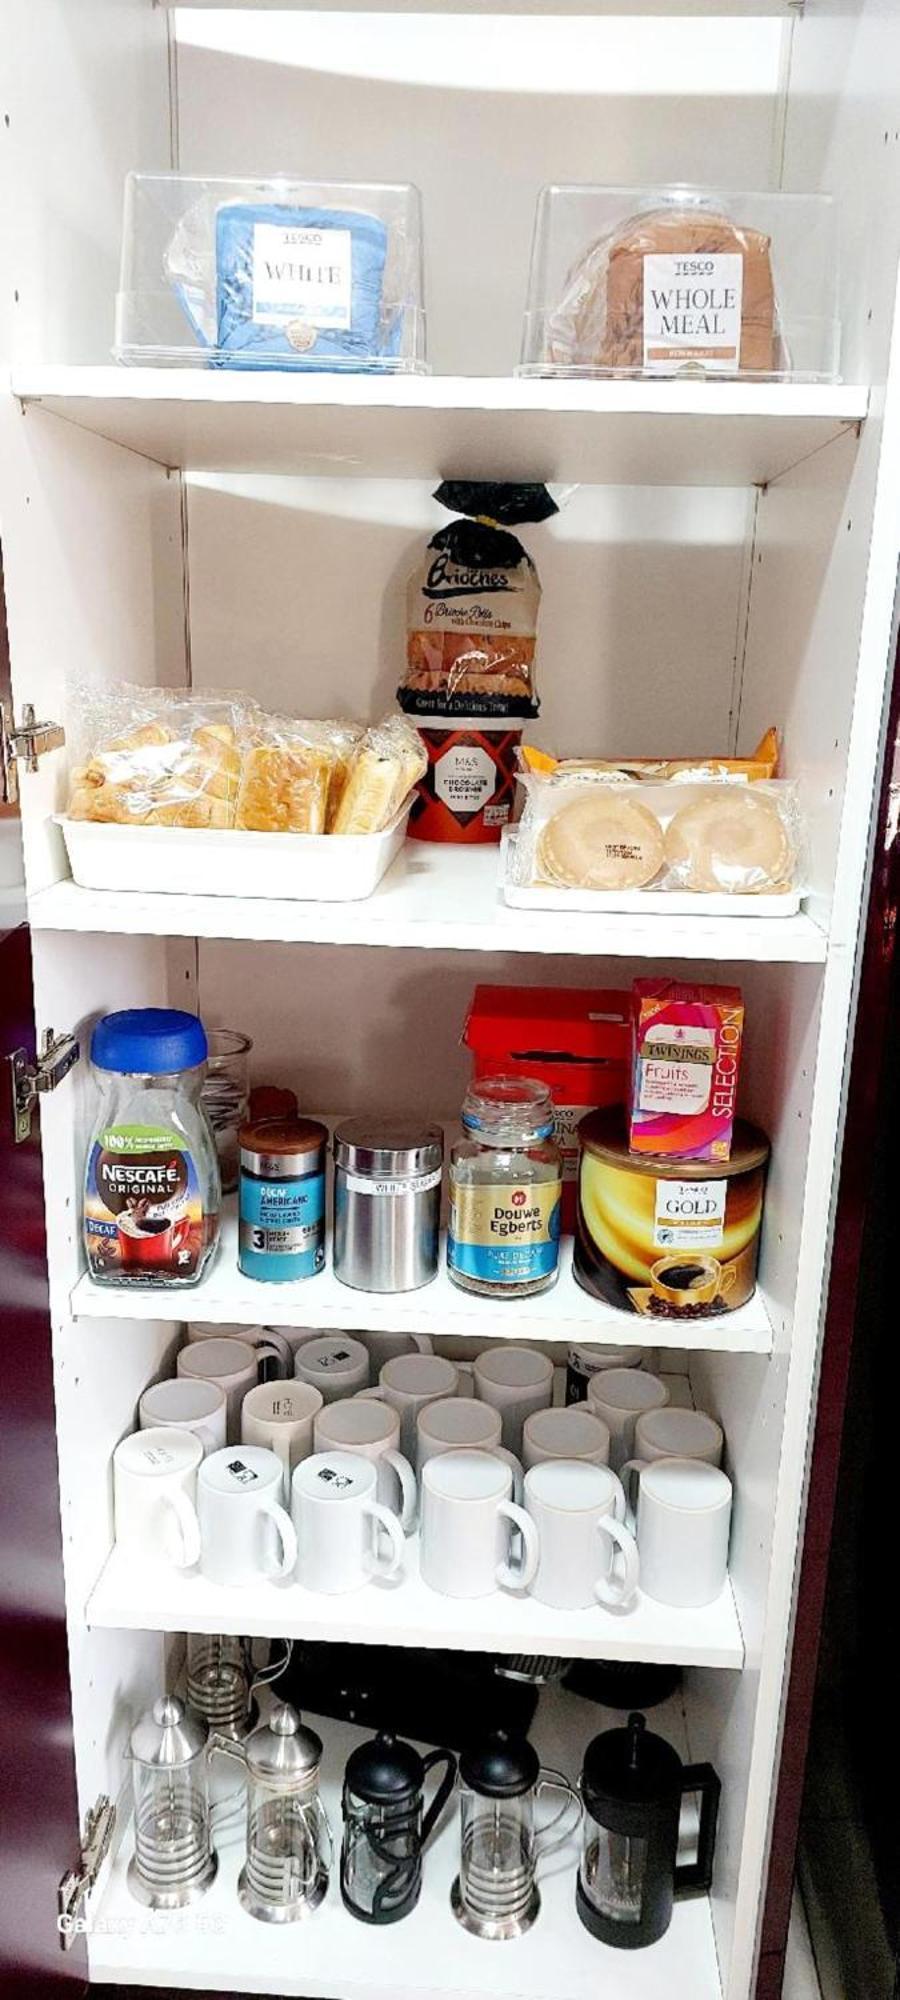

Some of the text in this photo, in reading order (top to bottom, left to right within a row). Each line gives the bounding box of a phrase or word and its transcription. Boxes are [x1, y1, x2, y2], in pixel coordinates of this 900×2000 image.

[265, 261, 341, 284] WHITE
[674, 261, 715, 273] TESCO
[651, 288, 737, 310] WHOLE
[660, 314, 726, 335] MEAL
[427, 553, 509, 588] Brioches
[424, 602, 434, 624] 6
[647, 1044, 710, 1061] TWININGS
[645, 1063, 689, 1080] Fruits
[712, 1007, 742, 1119] SELECTION
[109, 1183, 173, 1194] ORIGINAL
[494, 1207, 540, 1220] Douwe
[666, 1199, 717, 1214] GOLD
[88, 1221, 117, 1236] DECAF
[490, 1219, 543, 1236] Egberts
[252, 1230, 265, 1249] 3
